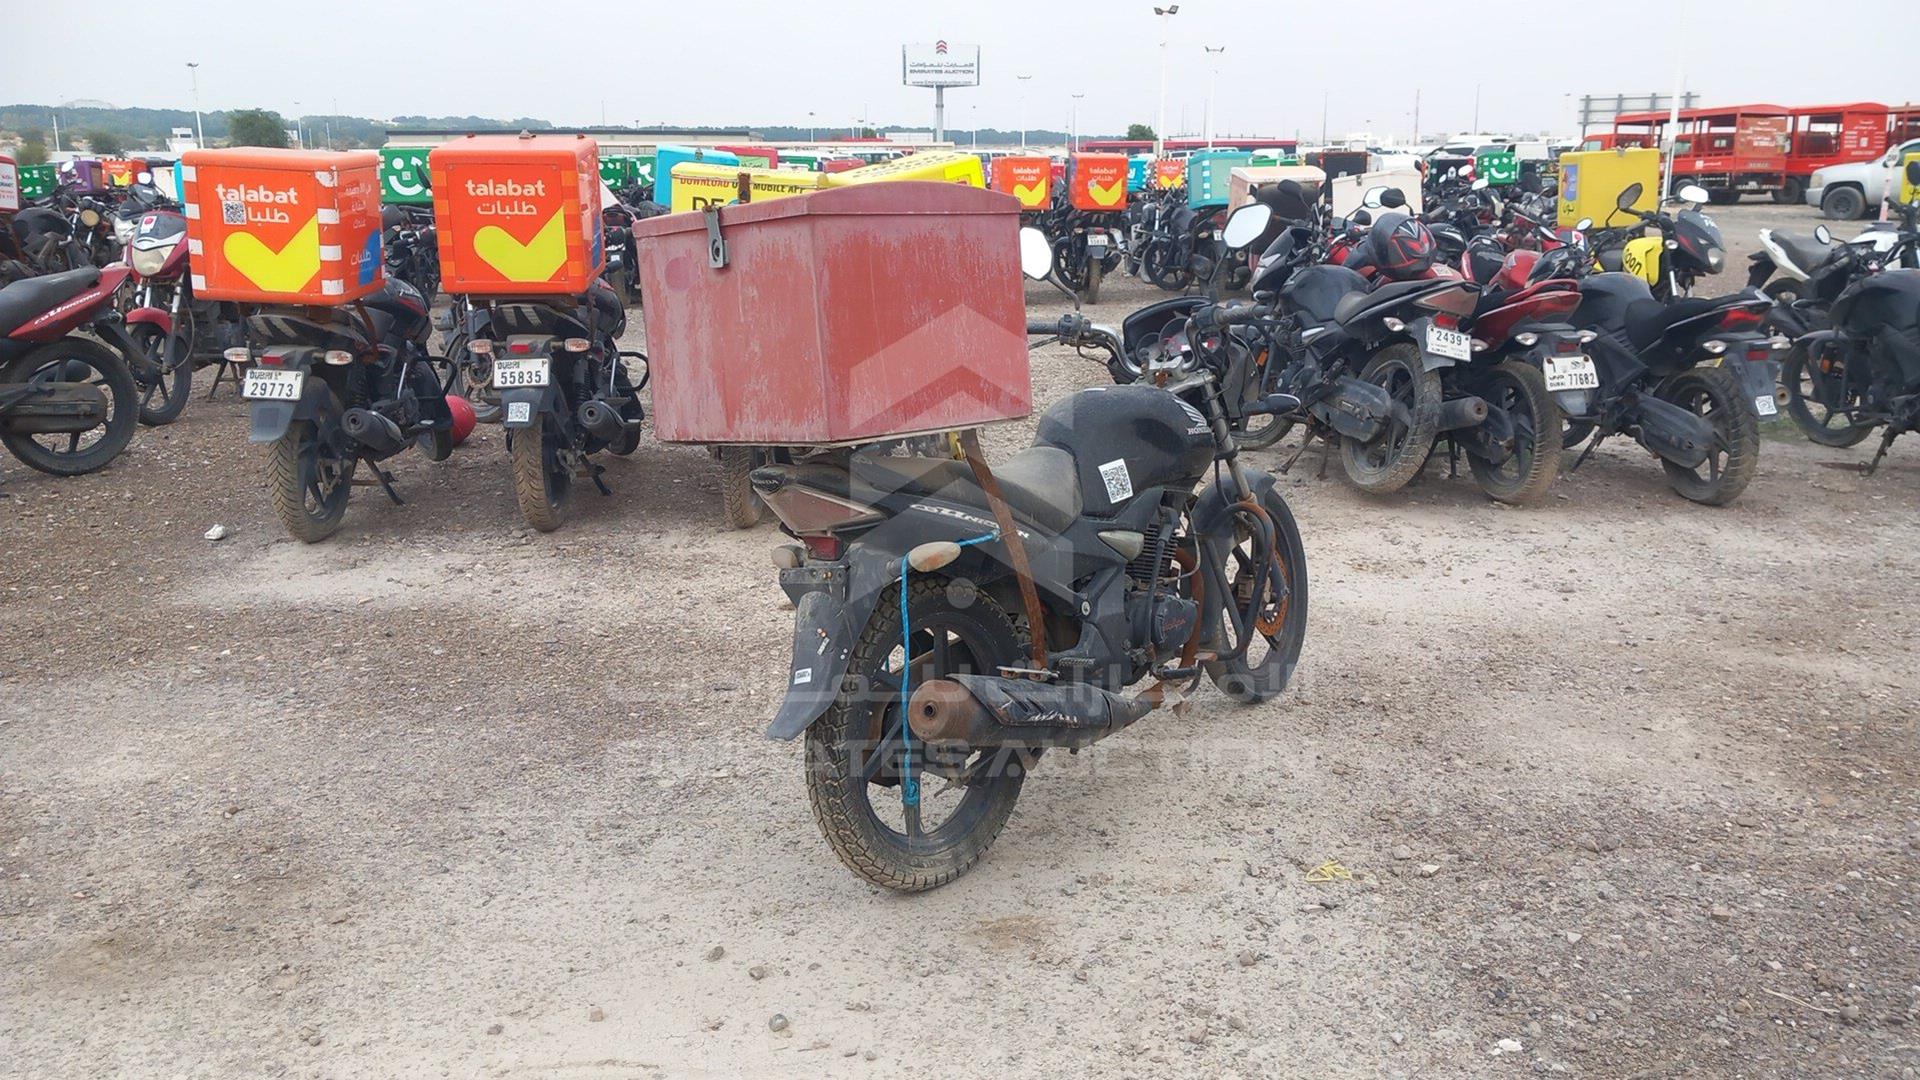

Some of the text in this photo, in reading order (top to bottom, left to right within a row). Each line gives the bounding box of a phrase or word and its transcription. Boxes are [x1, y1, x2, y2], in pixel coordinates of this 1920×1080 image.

[214, 183, 299, 205] talabat
[465, 179, 545, 197] talabat
[247, 206, 290, 227] طلبا
[477, 200, 537, 220] طلبات
[1436, 330, 1462, 346] 2439
[500, 370, 541, 385] 55835
[1567, 372, 1596, 386] 77682
[250, 382, 294, 398] 29773
